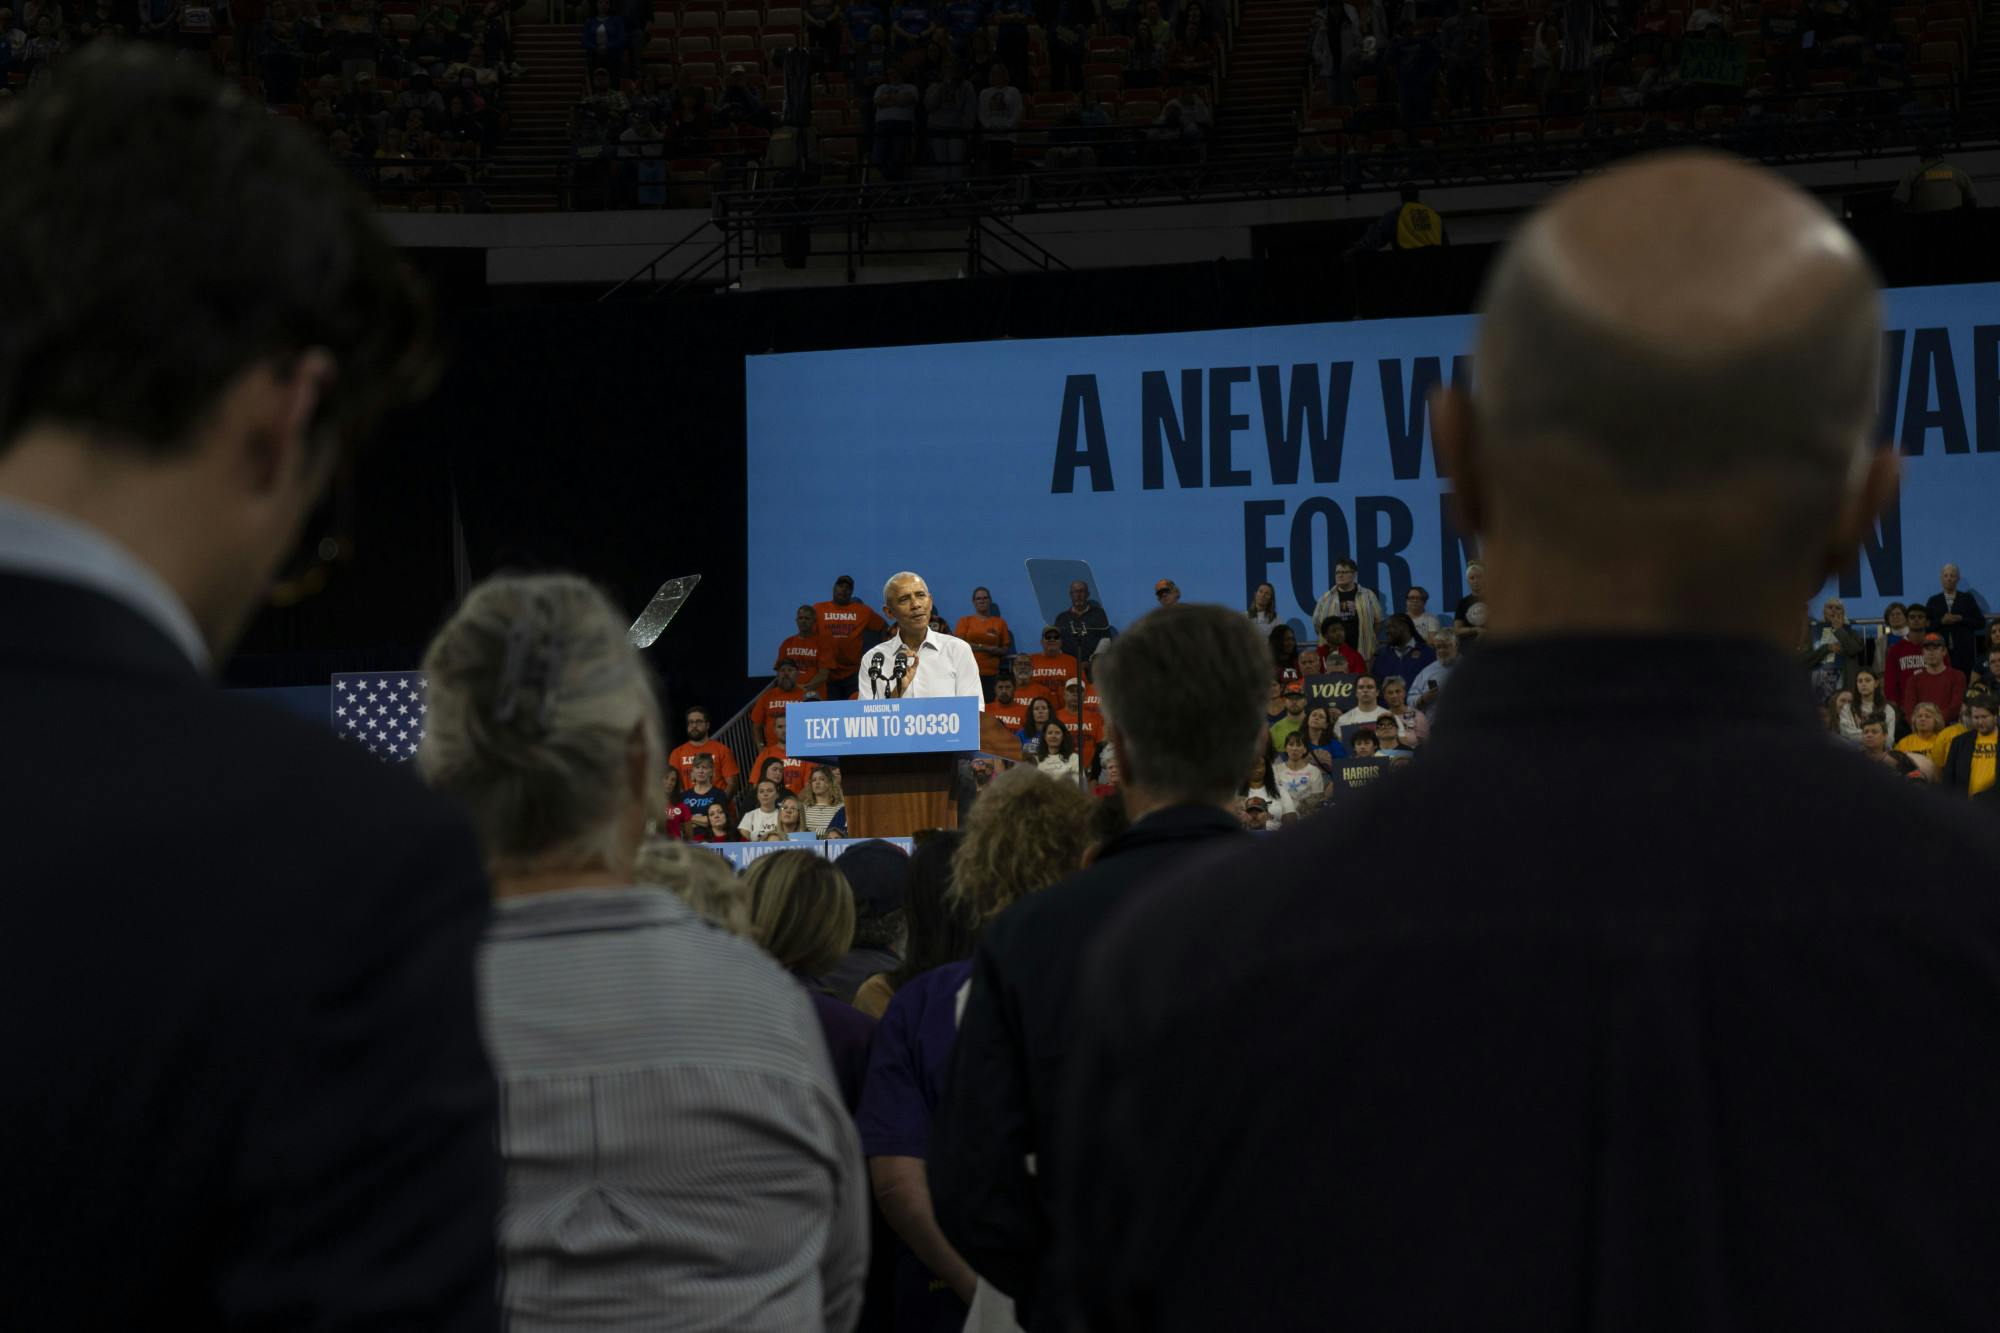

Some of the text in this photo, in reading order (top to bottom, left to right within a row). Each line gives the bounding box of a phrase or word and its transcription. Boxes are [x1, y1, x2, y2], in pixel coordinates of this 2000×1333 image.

[1051, 373, 1114, 493] A
[1142, 361, 1354, 490] NEW
[1244, 496, 1412, 619] FOR
[824, 612, 857, 621] LIUNA!
[787, 647, 818, 657] LIUNA!
[1032, 668, 1067, 677] LIUNA!
[1312, 681, 1353, 698] vote
[864, 704, 900, 713] MADISON, WI
[805, 713, 960, 739] TEXT WIN TO 30330
[1343, 766, 1379, 780] HARRIS
